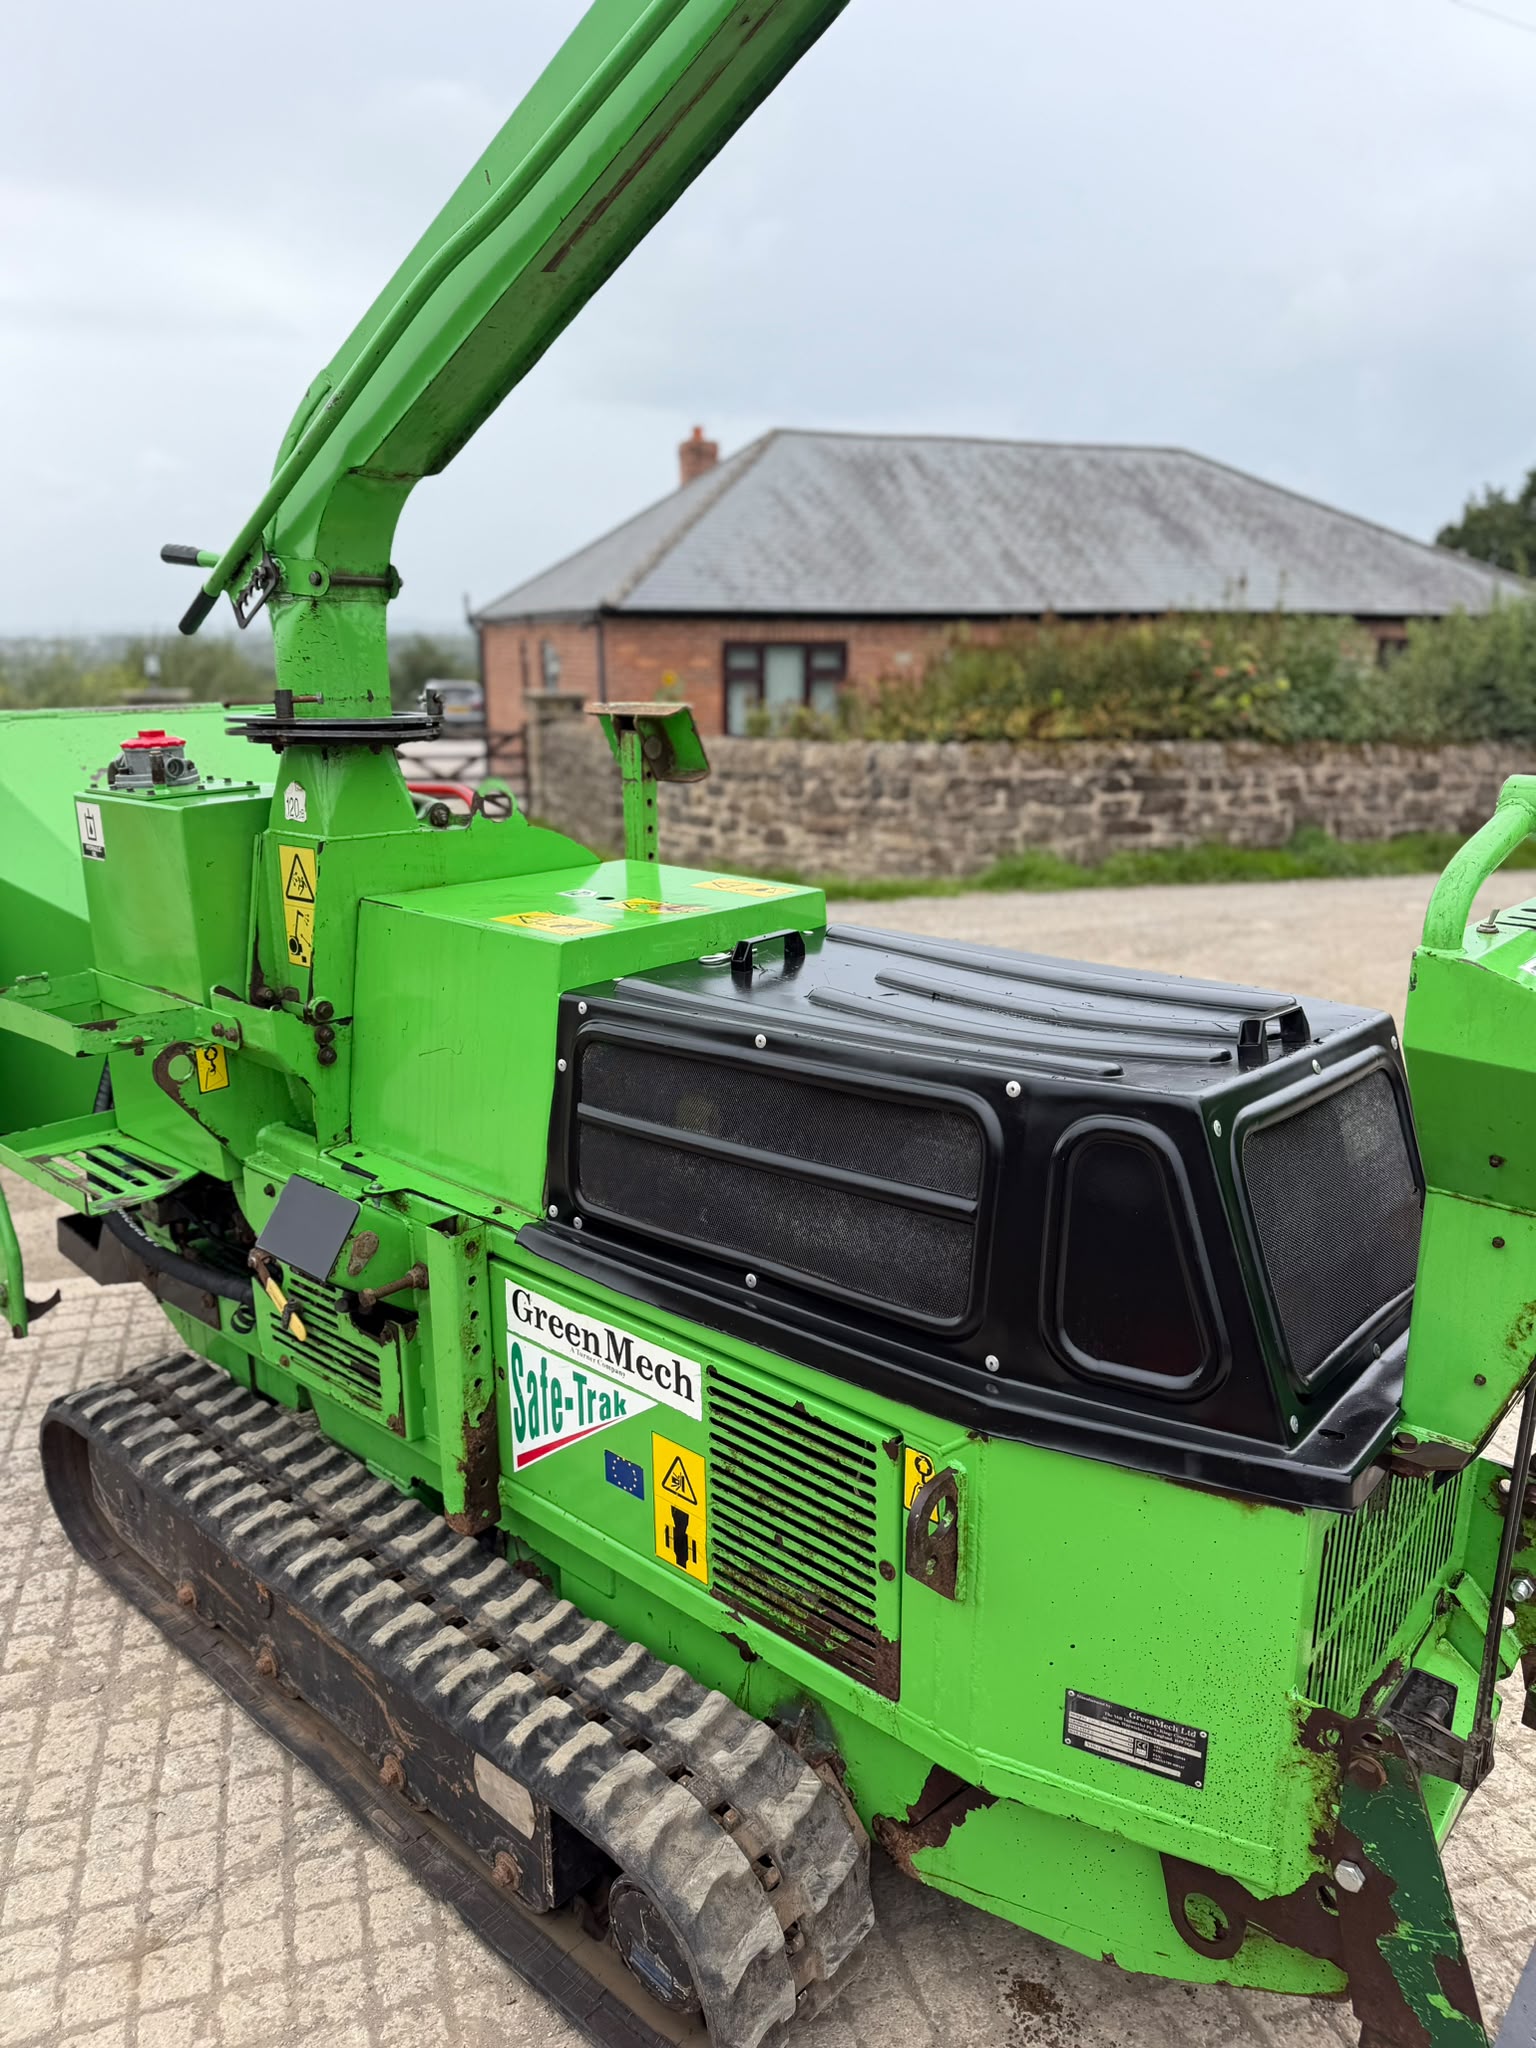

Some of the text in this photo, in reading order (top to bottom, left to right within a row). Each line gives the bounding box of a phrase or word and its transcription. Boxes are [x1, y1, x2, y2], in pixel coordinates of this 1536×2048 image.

[512, 1289, 695, 1403] GreenMech
[597, 1359, 626, 1379] Company
[511, 1342, 627, 1443] Safe-Trak
[1128, 1711, 1178, 1732] GreenMech
[1180, 1726, 1196, 1738] Ltd
